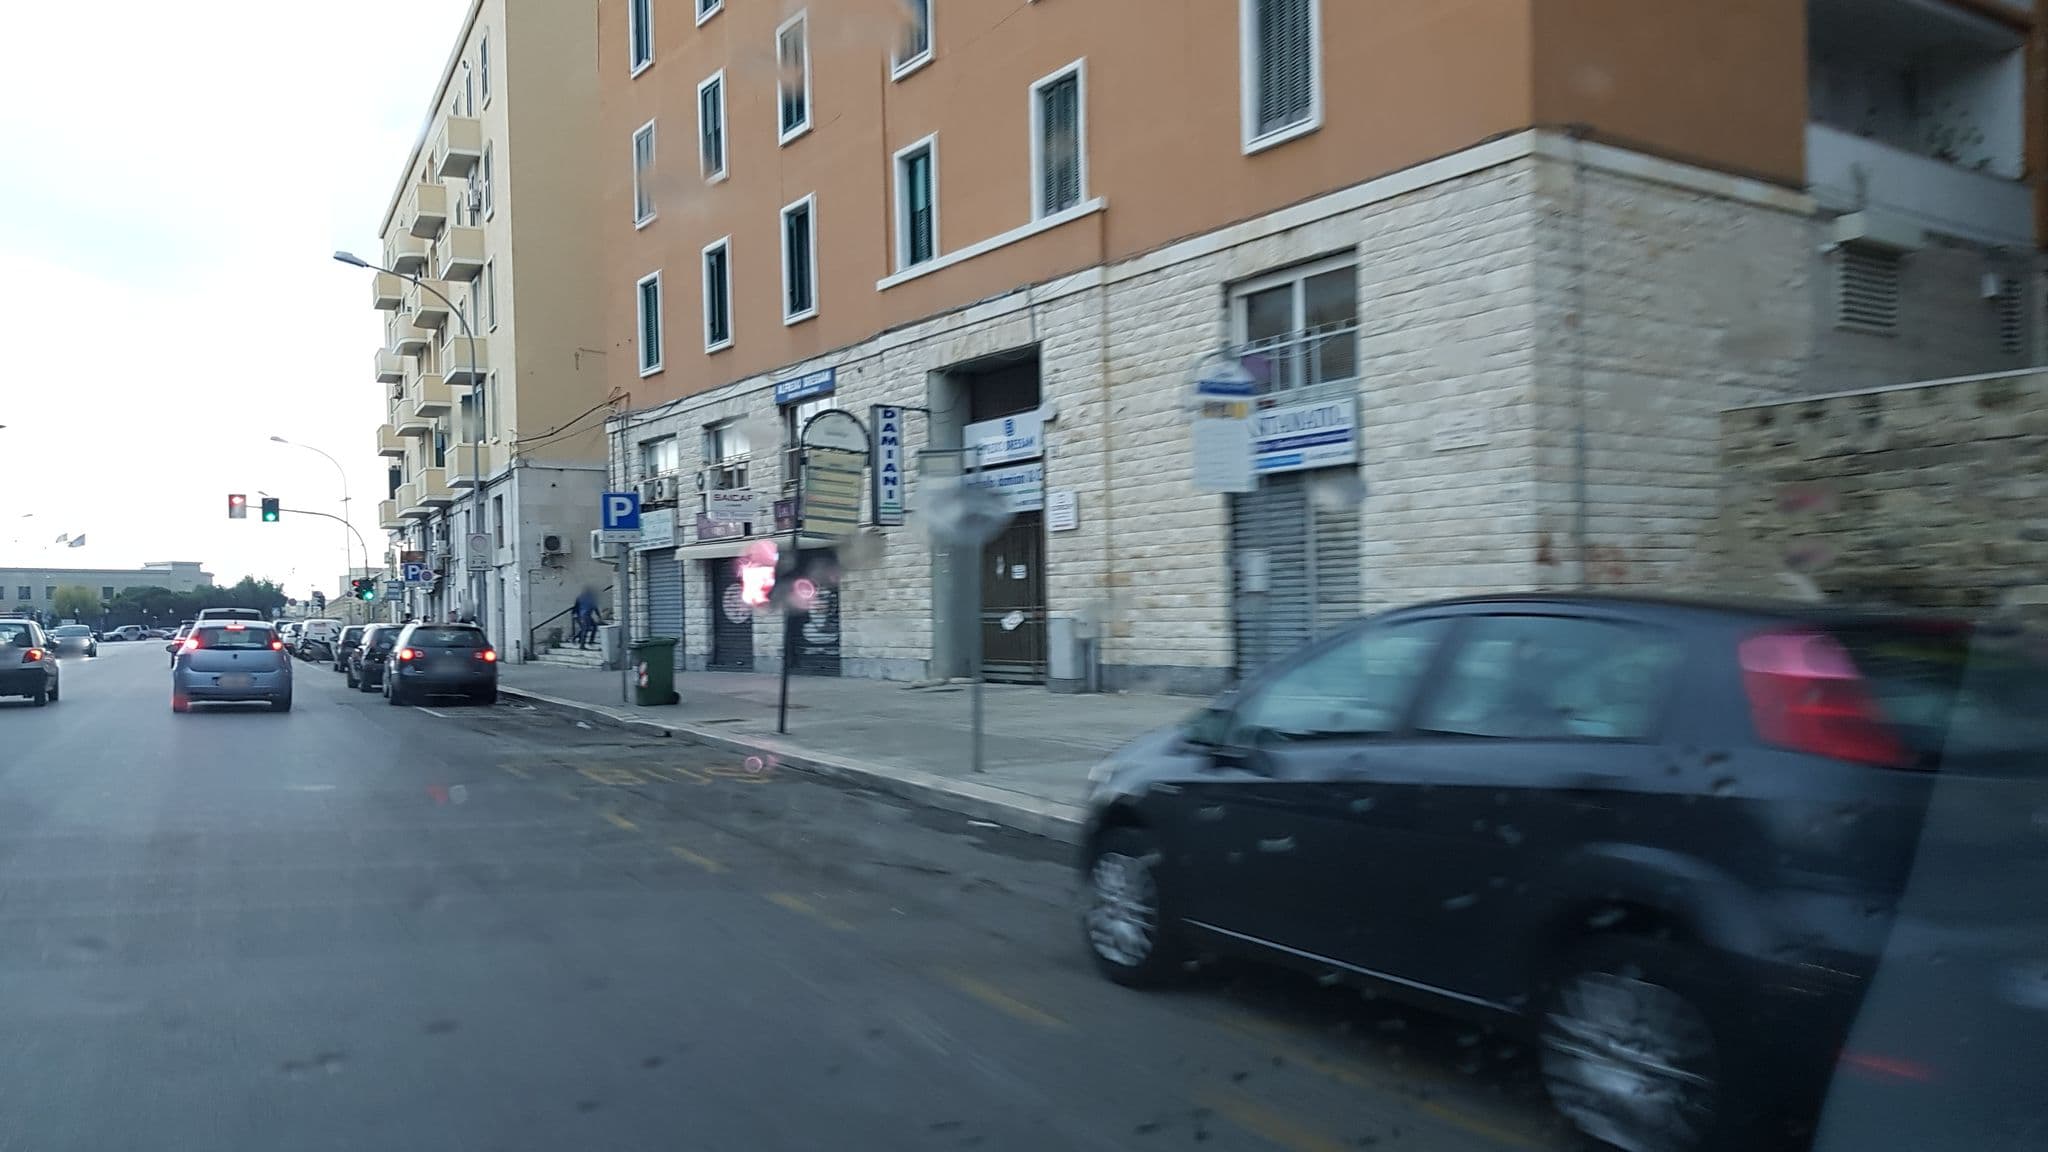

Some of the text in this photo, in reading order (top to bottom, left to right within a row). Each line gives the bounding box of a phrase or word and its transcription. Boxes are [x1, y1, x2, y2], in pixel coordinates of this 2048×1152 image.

[881, 410, 899, 500] DAMIANI
[609, 496, 633, 527] P
[408, 565, 420, 580] P
